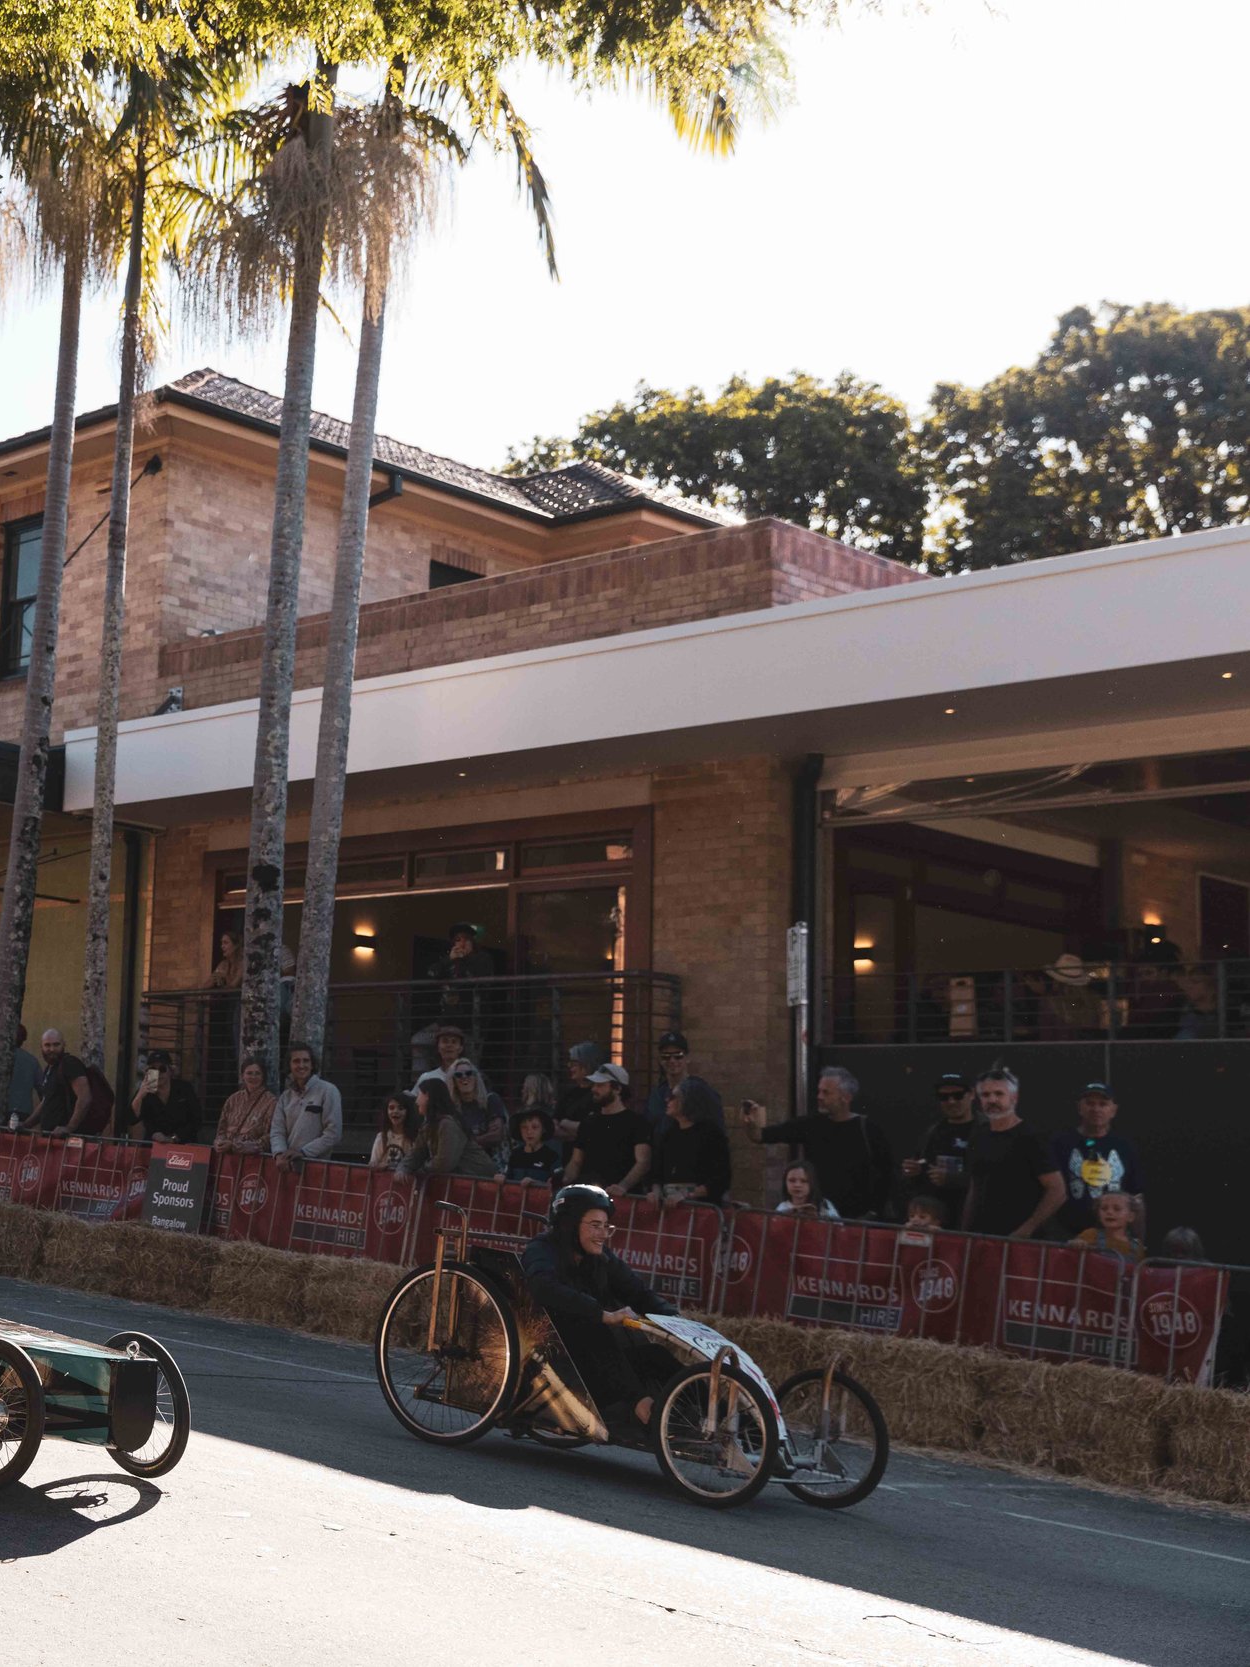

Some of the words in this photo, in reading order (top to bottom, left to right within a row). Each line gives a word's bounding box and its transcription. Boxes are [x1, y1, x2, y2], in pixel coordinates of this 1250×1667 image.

[168, 1154, 191, 1168] Elders
[62, 1179, 121, 1198] KENNARDS
[162, 1178, 189, 1193] Proud
[152, 1191, 194, 1209] Sponsors
[151, 1215, 187, 1230] Bangalow
[296, 1203, 364, 1226] KENNARDS
[613, 1247, 698, 1274] KENNARDS
[661, 1278, 697, 1296] HIRE
[796, 1274, 899, 1303] KENNARDS
[918, 1276, 954, 1302] 1948
[859, 1308, 896, 1327] HIRE
[1007, 1298, 1130, 1333] KENNARDS
[1150, 1312, 1197, 1337] 1948
